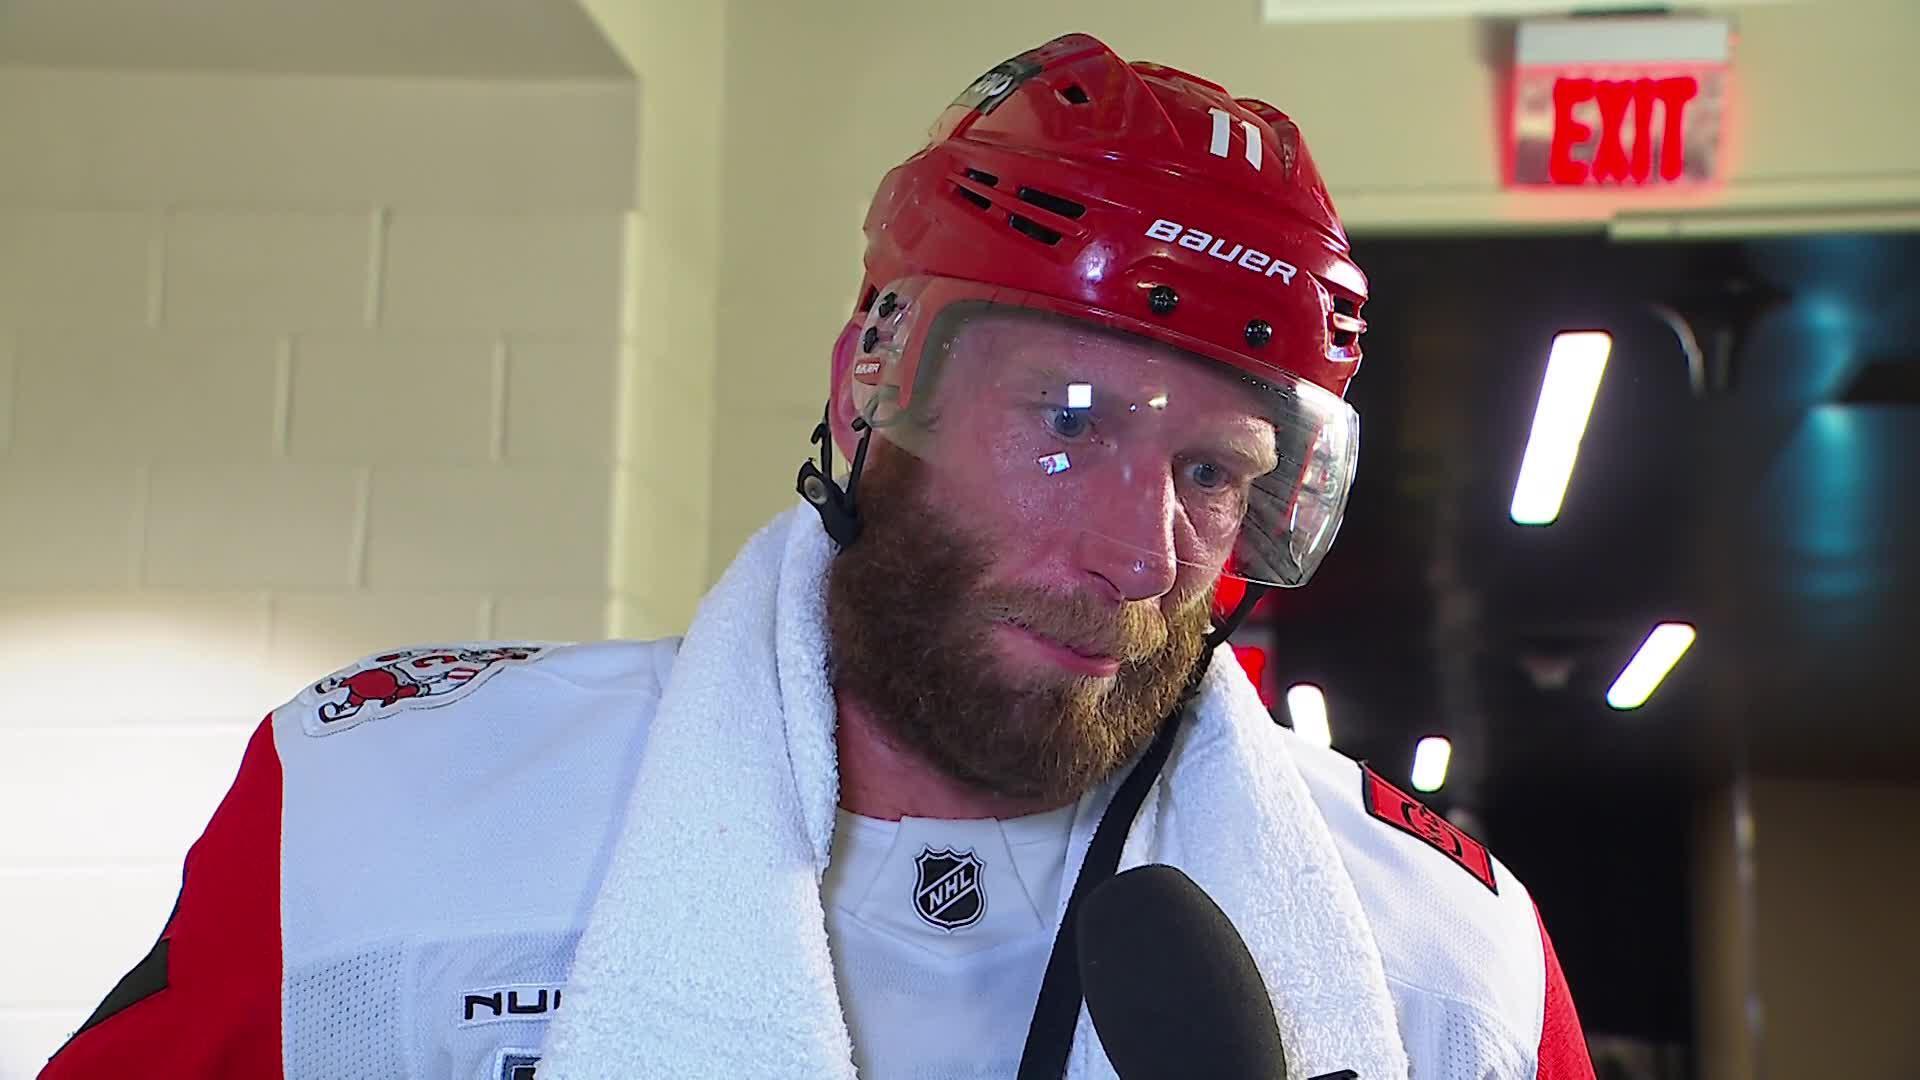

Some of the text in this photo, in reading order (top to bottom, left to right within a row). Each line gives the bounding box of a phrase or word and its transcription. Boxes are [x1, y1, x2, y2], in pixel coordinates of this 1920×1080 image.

[1208, 107, 1262, 172] 11
[1551, 76, 1697, 185] EXIT
[929, 869, 972, 912] NHL
